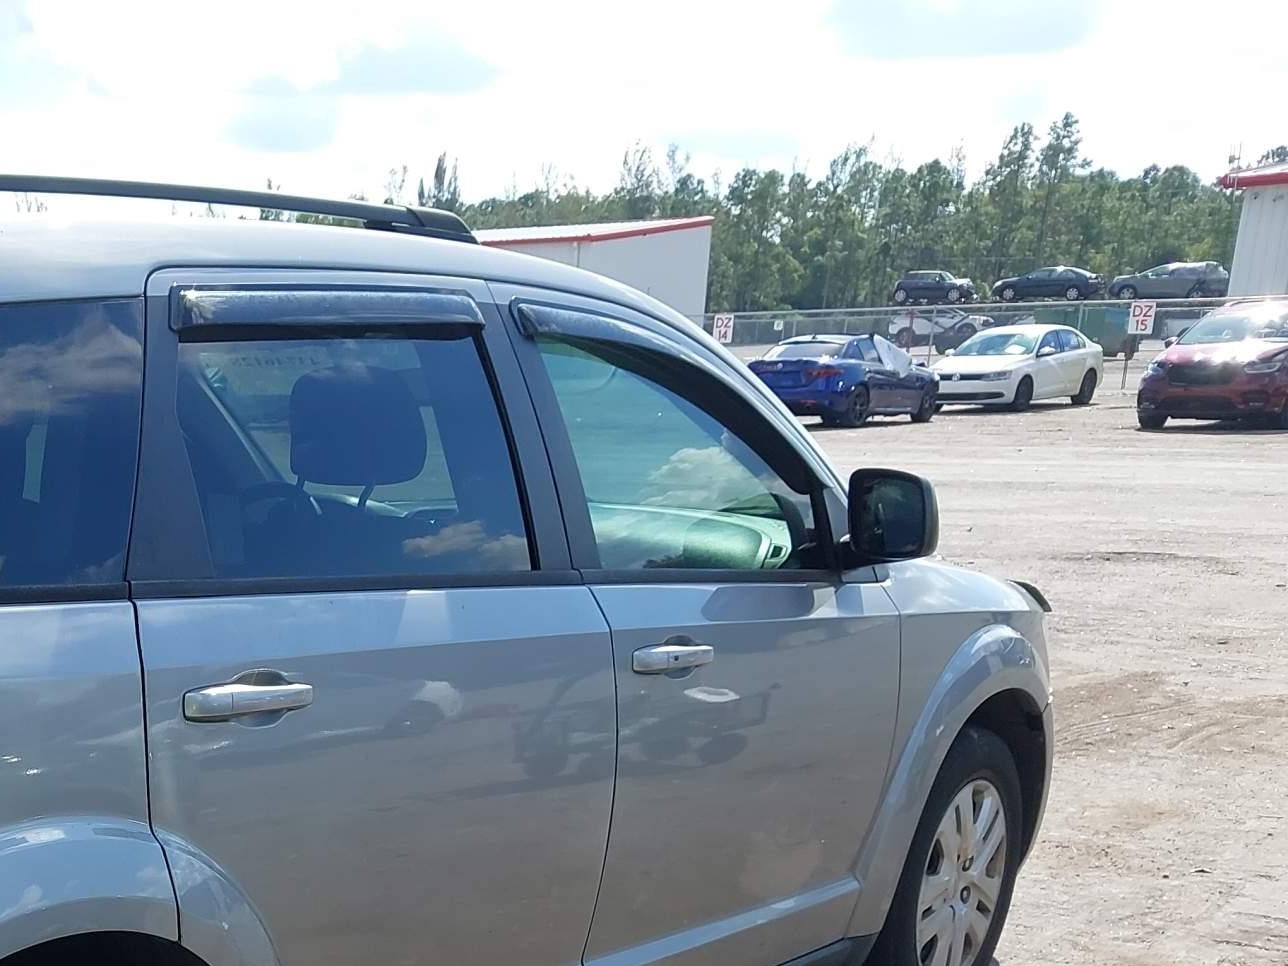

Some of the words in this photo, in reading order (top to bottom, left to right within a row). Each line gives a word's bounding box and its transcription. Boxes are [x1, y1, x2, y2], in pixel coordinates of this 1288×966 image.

[1132, 305, 1154, 318] DZ
[715, 317, 732, 329] DZ
[1135, 319, 1148, 332] 15
[718, 329, 728, 341] 14
